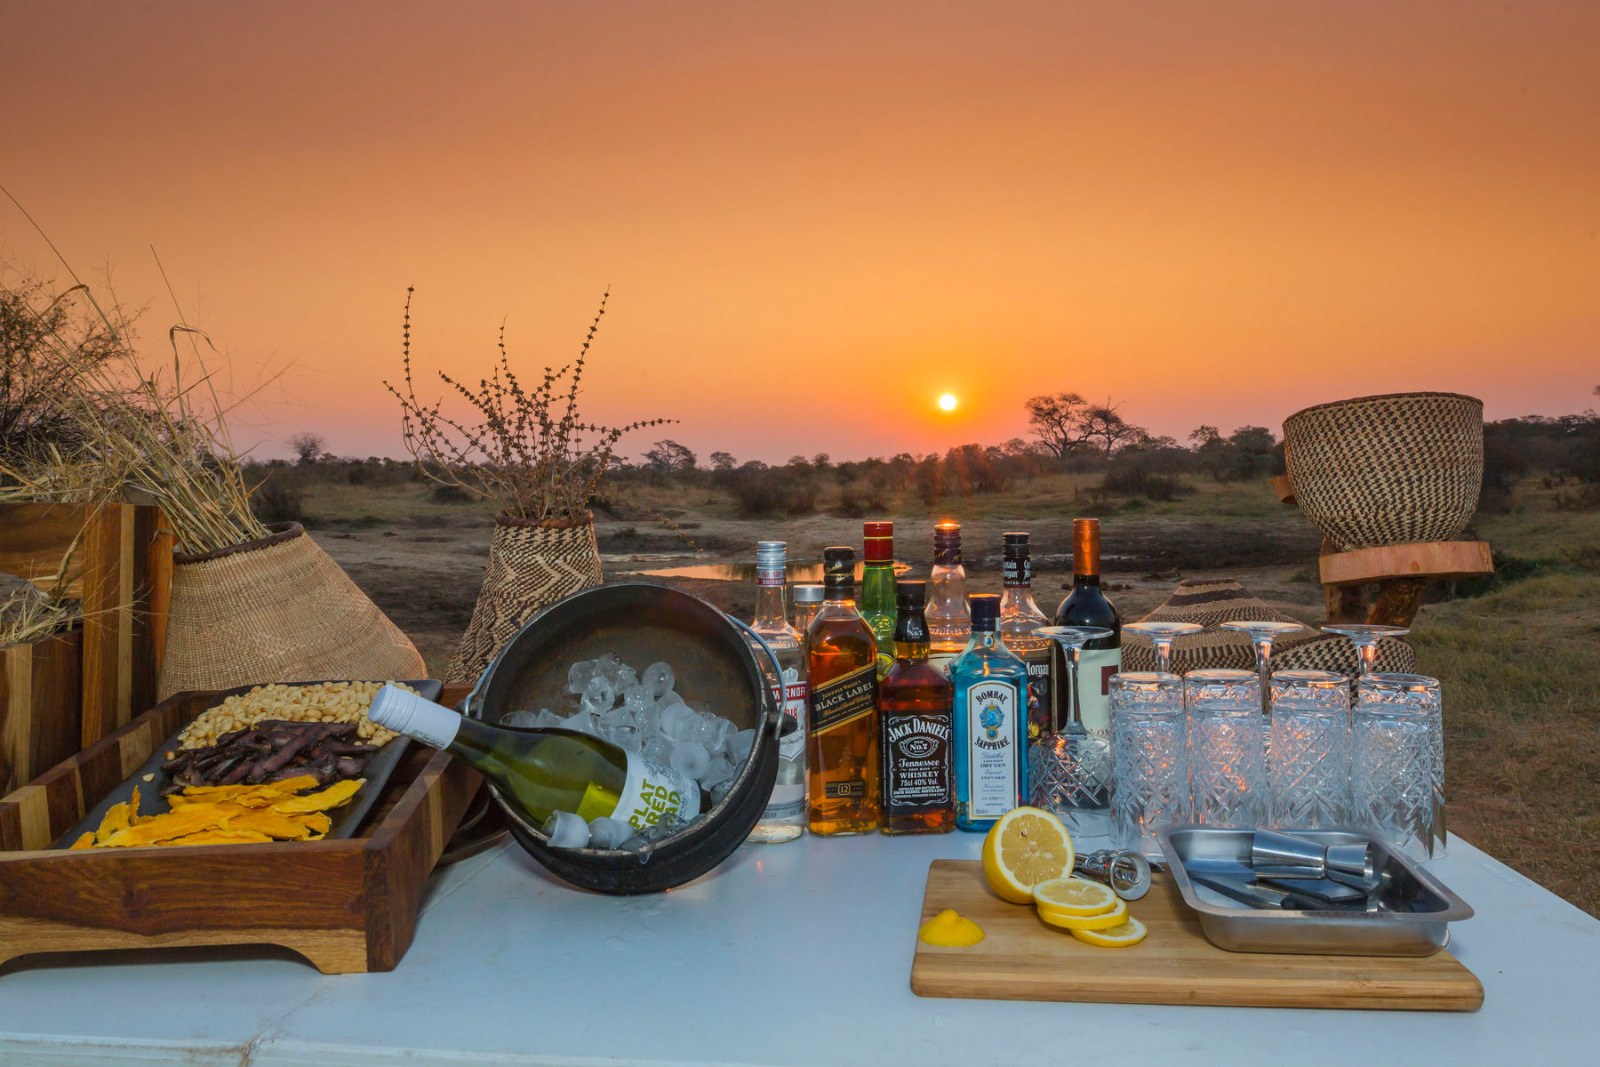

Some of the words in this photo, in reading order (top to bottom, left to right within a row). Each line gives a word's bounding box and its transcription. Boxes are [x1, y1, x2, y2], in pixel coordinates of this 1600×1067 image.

[815, 694, 844, 711] BLACK
[846, 682, 874, 698] LABEL
[976, 690, 1009, 705] BOMBAY
[888, 723, 912, 743] JACK
[913, 718, 950, 740] DANIEL'S
[974, 736, 1010, 750] SAPPHIRE
[899, 758, 940, 767] Tennessee
[900, 771, 939, 779] WHISKEY
[628, 778, 655, 833] PLAT
[641, 785, 668, 831] RED
